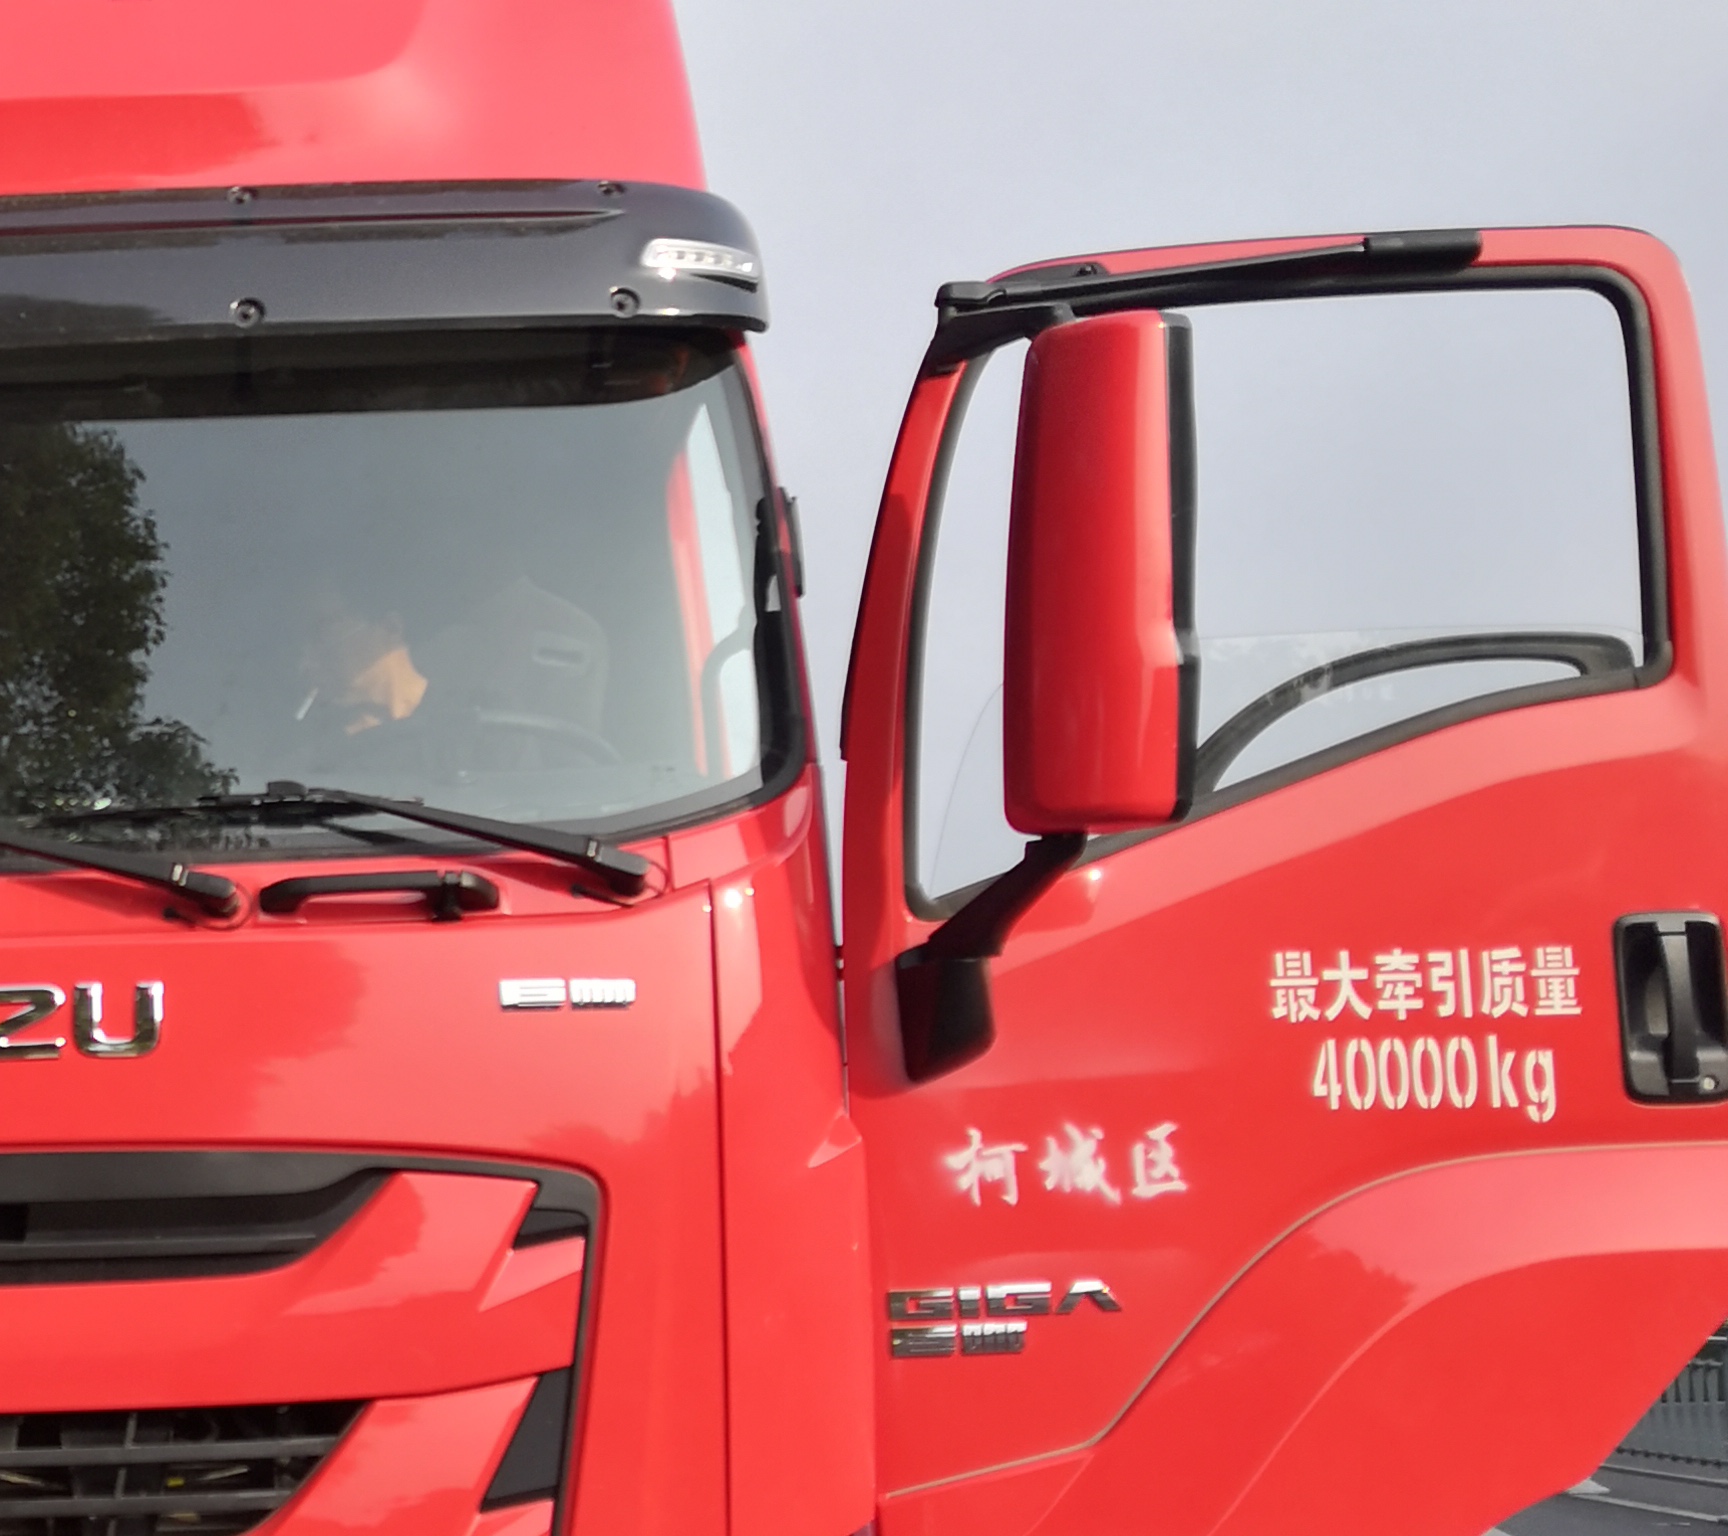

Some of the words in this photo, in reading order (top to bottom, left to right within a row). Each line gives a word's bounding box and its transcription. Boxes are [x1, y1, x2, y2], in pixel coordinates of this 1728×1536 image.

[1269, 945, 1583, 1022] 最大牵引质量
[944, 1120, 1190, 1207] 柯城区
[887, 1277, 1123, 1322] GIGA
